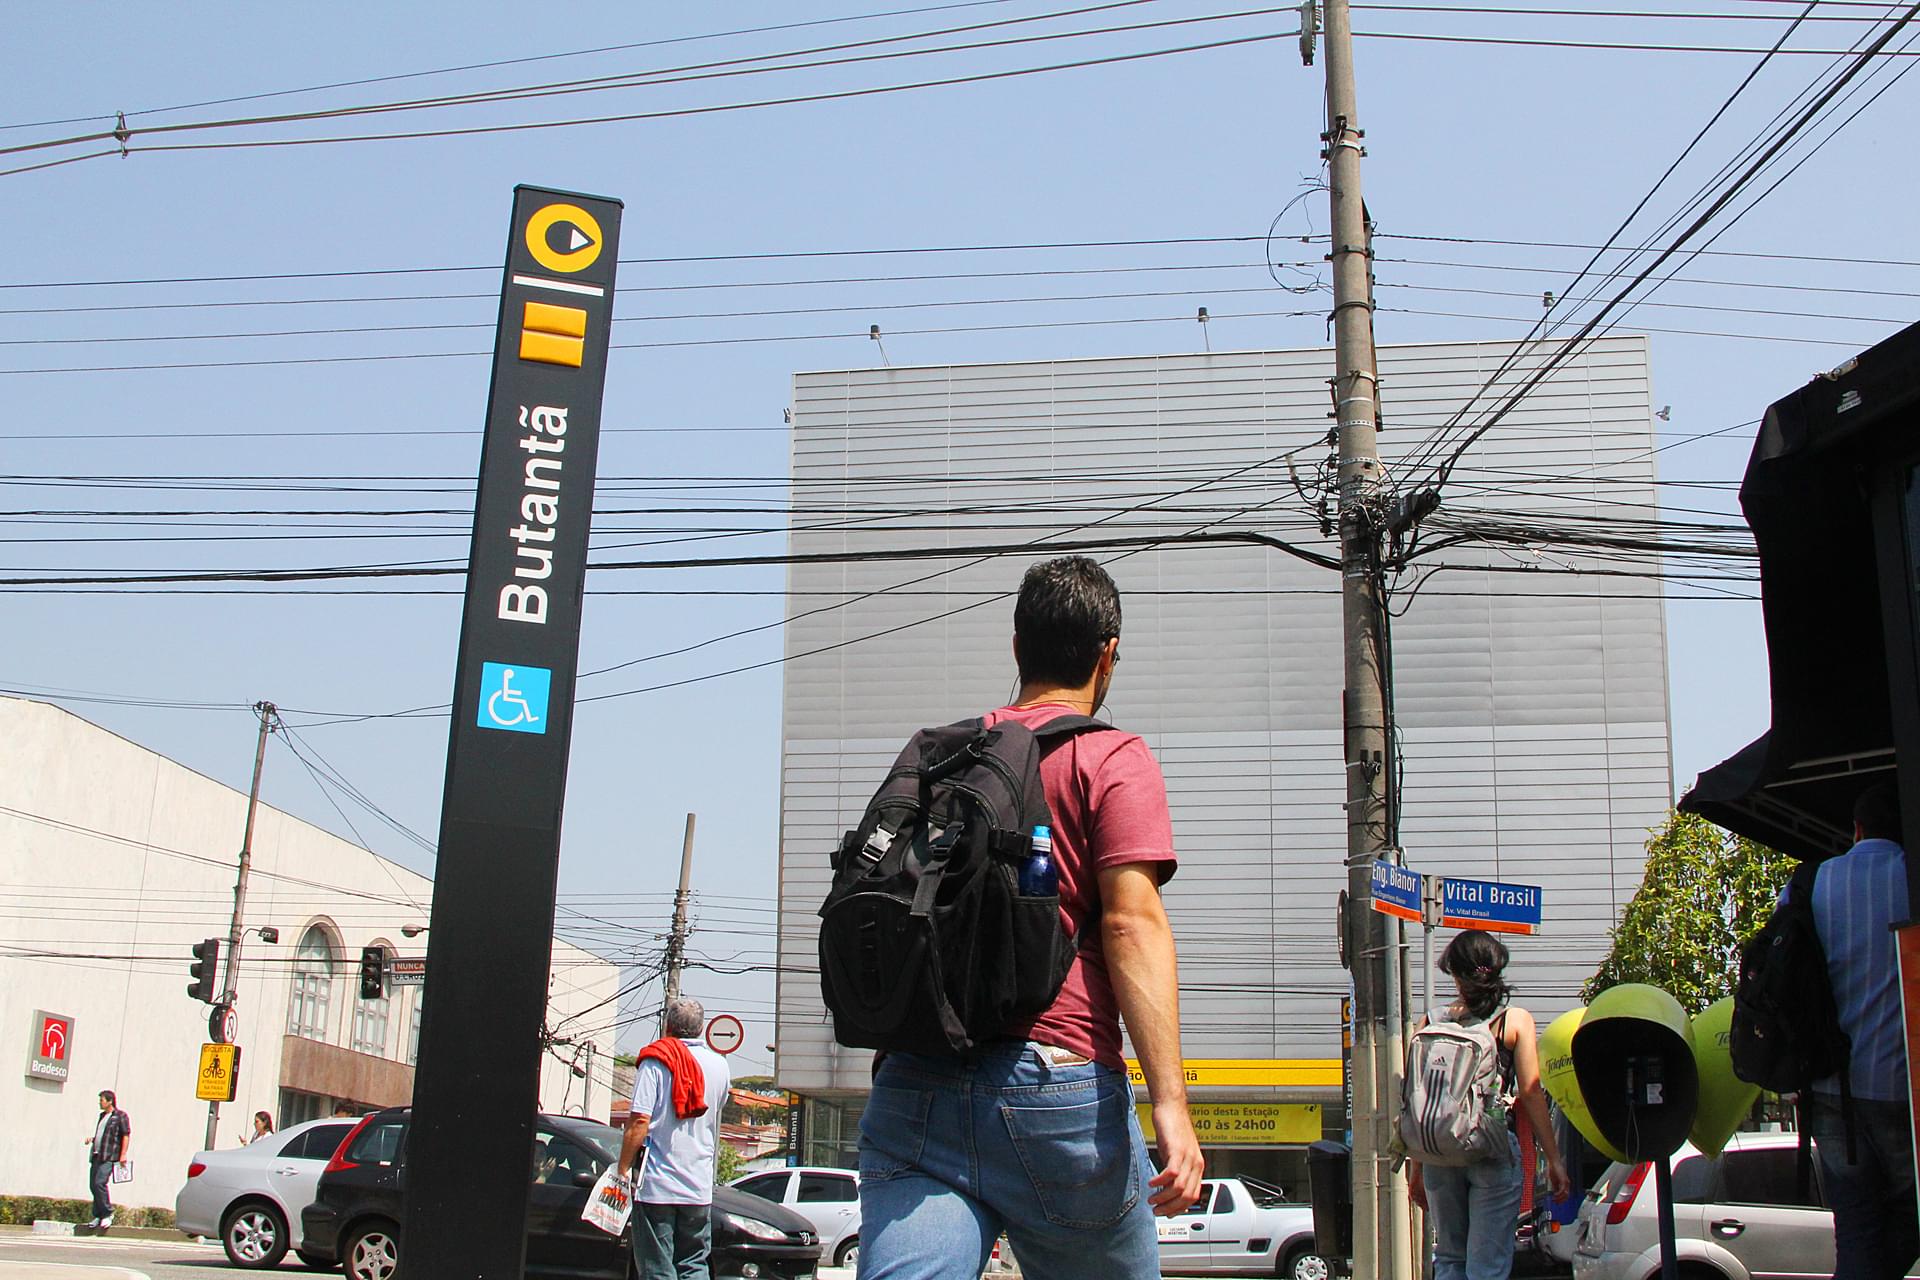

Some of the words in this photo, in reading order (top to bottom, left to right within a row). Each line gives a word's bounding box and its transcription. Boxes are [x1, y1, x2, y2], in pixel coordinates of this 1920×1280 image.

[498, 405, 568, 624] Butantã
[1372, 861, 1388, 888] Eng.
[1390, 867, 1416, 893] Bianor
[1446, 882, 1483, 903] Vital
[1490, 887, 1535, 907] Brasil
[1456, 908, 1471, 916] Vital
[397, 962, 425, 970] NUNCA
[31, 1059, 68, 1078] Bradesco
[1213, 1107, 1239, 1116] desta
[1243, 1107, 1279, 1118] Estação
[1215, 1119, 1230, 1130] às
[1234, 1119, 1276, 1130] 24h00
